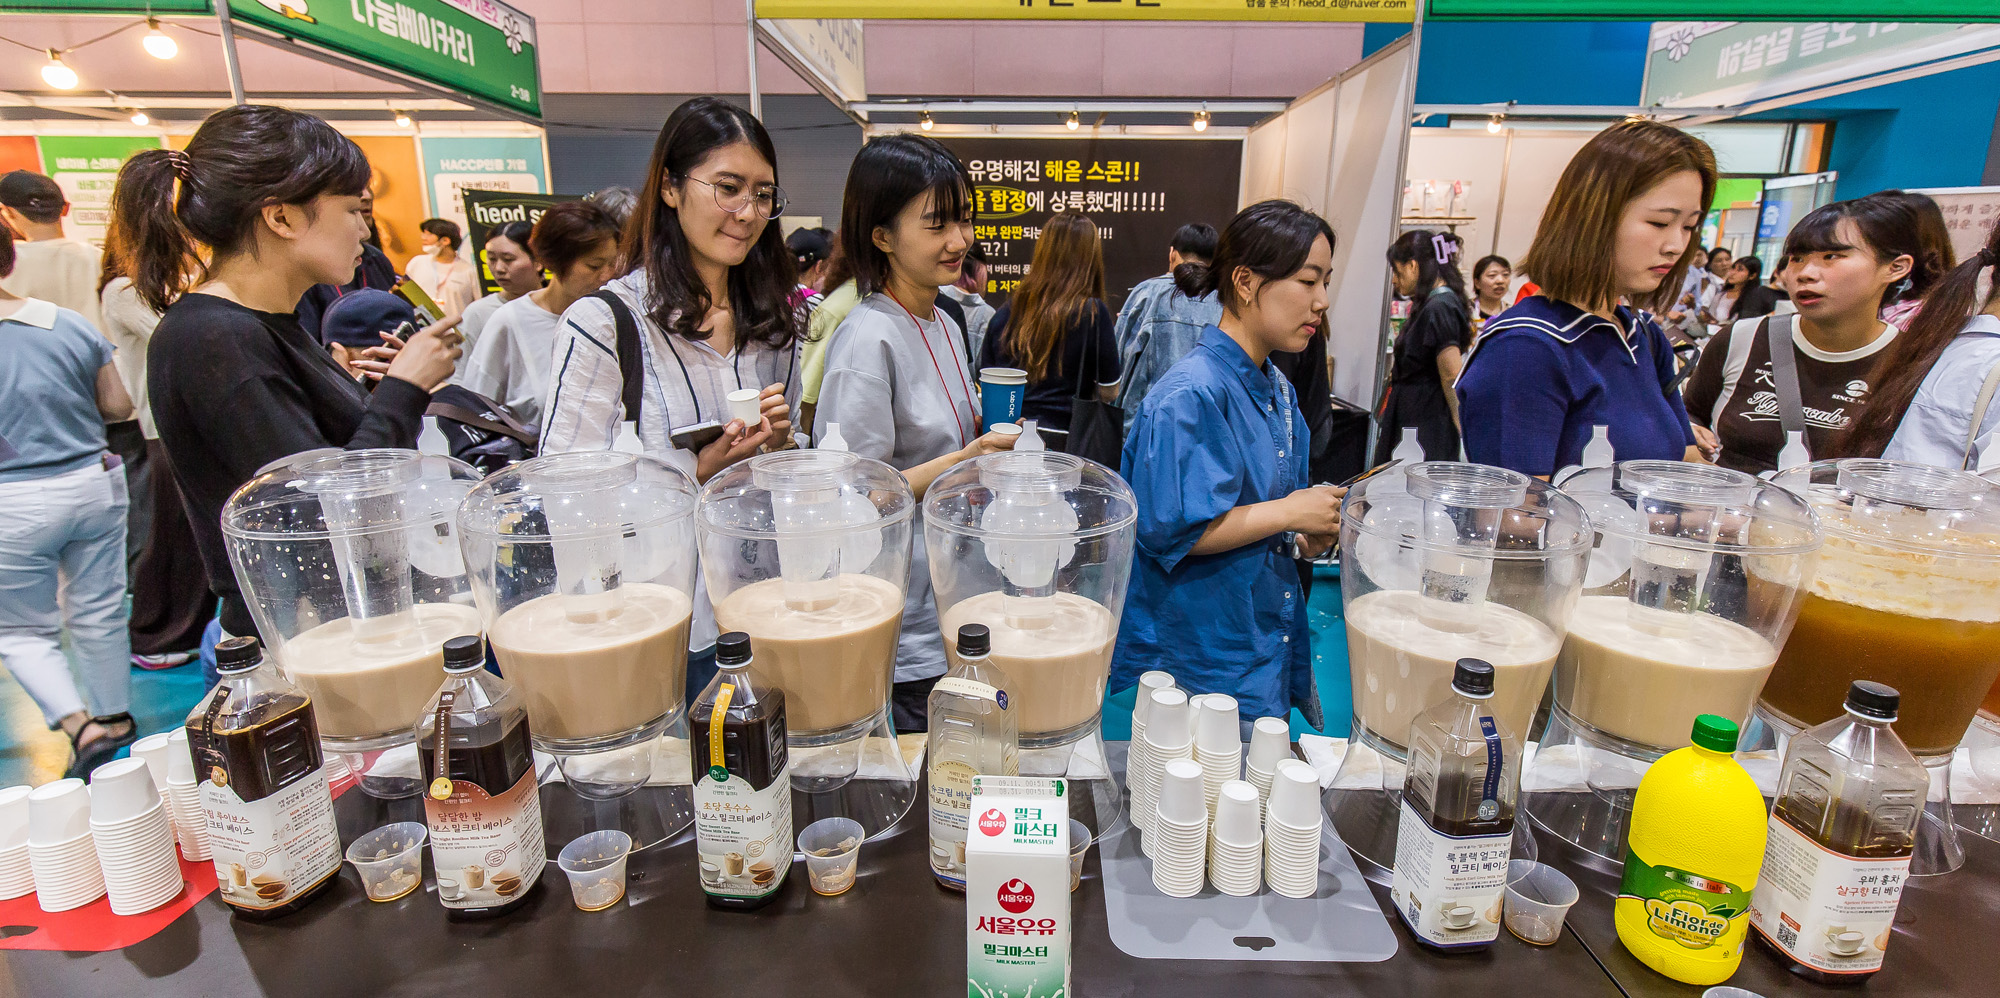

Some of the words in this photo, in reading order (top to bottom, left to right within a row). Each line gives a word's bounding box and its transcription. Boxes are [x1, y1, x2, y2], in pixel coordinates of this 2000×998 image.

[350, 0, 475, 67] 나눔베이커리
[967, 159, 1040, 182] 유명해진
[1085, 160, 1140, 183] 스콘!!
[990, 189, 1044, 212] 합정에
[1049, 191, 1165, 213] 상륙했대!!!!!
[974, 225, 998, 240] 전부
[994, 264, 1021, 275] 버터의
[1831, 393, 1855, 403] SINCE
[931, 784, 953, 798] 슈크림
[703, 802, 721, 812] 초당
[723, 802, 752, 813] 옥수수
[1014, 807, 1042, 821] 밀크
[217, 811, 250, 824] 루이보스
[438, 811, 469, 823] 달달한
[472, 811, 483, 822] 밤
[482, 816, 513, 830] 베이스
[746, 811, 772, 823] 베이스
[226, 824, 255, 835] 베이스
[979, 820, 1005, 828] 서울우유
[1014, 822, 1057, 837] 마스터
[1459, 851, 1477, 863] 블랙
[1451, 863, 1479, 874] 밀크티
[1483, 861, 1507, 871] 베이스
[1676, 873, 1694, 885] Made
[1706, 882, 1722, 892] Italy
[1858, 875, 1878, 885] 우바
[1880, 874, 1900, 885] 홍차
[1836, 885, 1869, 898] 살구향
[1872, 887, 1881, 896] 티
[999, 894, 1033, 903] 서울우유
[1654, 907, 1720, 936] Limone
[1672, 907, 1708, 927] Fior
[975, 916, 1057, 936] 서울우유
[983, 943, 1048, 957] 밀크마스터
